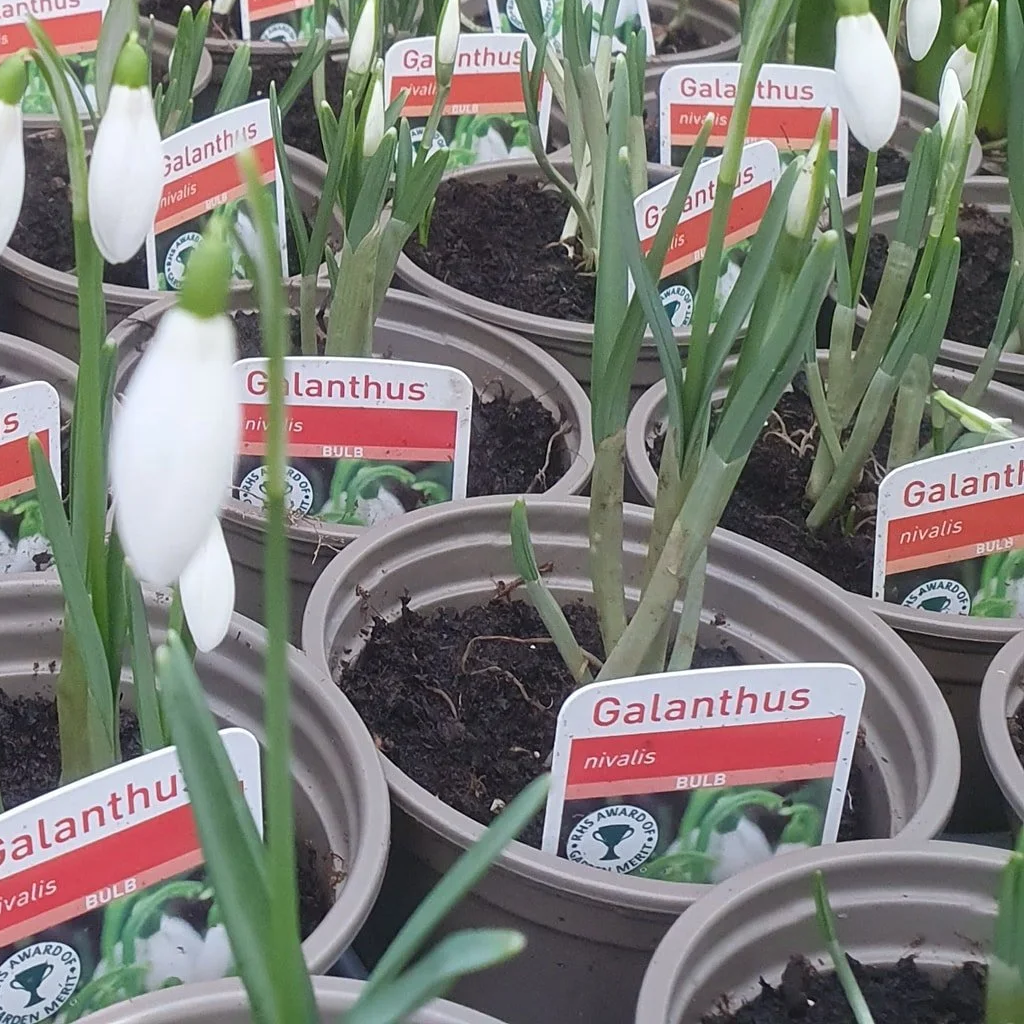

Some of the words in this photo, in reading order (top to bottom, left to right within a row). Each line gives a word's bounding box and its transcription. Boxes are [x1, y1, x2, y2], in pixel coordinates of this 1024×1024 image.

[403, 47, 521, 70] Ganthus
[399, 82, 437, 96] nivali
[680, 77, 814, 101] Galathus
[679, 112, 728, 126] nivis
[160, 182, 198, 209] nivalis
[645, 166, 754, 229] Gants
[245, 416, 304, 433] nivlis
[322, 446, 364, 459] BULB
[299, 481, 311, 493] OF
[899, 519, 963, 545] nivalis
[976, 536, 1014, 555] BULB
[918, 580, 960, 596] AWARD
[956, 591, 969, 604] OF
[592, 685, 811, 727] Galanthus
[583, 748, 657, 771] nivalis
[675, 772, 727, 791] BULB
[570, 818, 594, 842] RHS
[596, 807, 647, 822] AWARD
[642, 821, 656, 836] OF
[616, 843, 653, 874] MERIT
[84, 877, 138, 911] BULB
[9, 944, 63, 969] AWARD
[60, 951, 77, 966] OF
[43, 975, 78, 1015] MERIT
